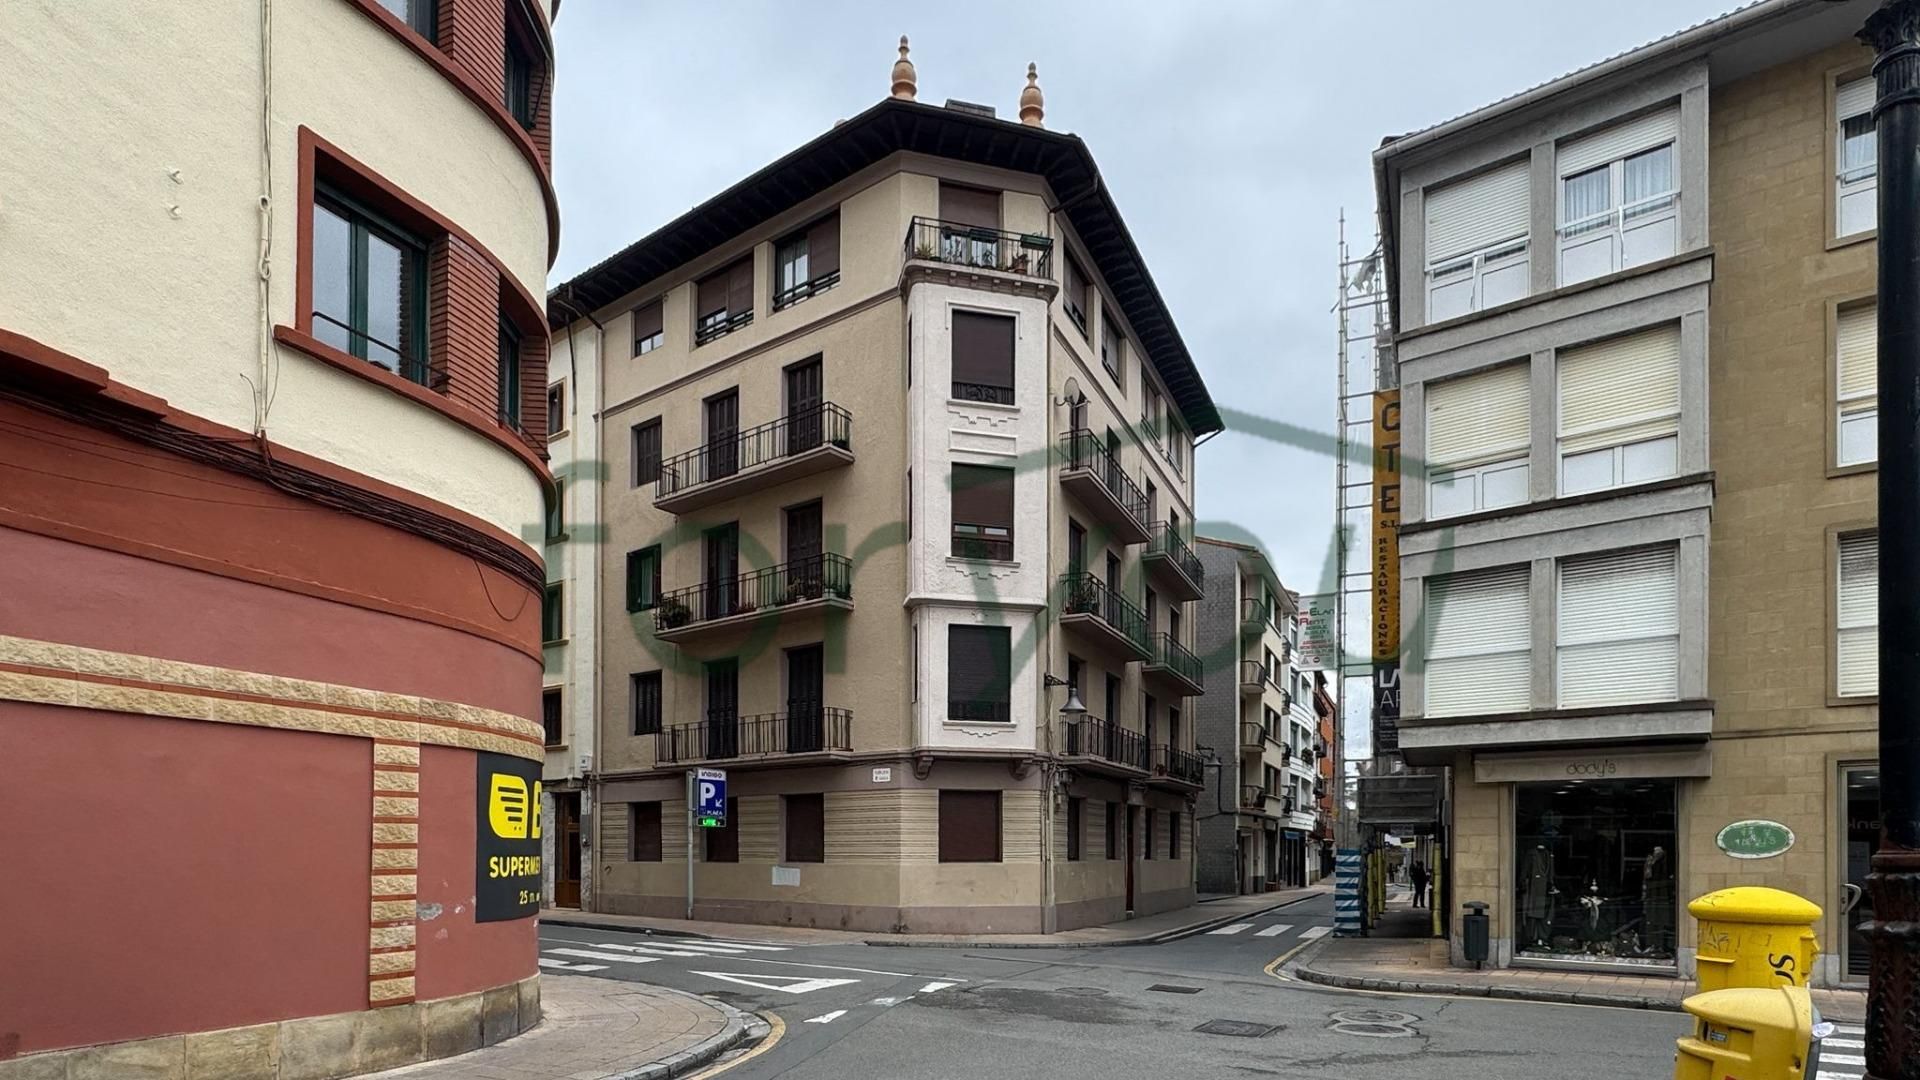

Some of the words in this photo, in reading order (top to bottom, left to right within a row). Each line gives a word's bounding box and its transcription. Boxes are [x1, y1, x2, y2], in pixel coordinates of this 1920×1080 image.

[1378, 537, 1389, 656] RESTAURACIONES
[1566, 760, 1616, 777] dody's
[700, 782, 716, 807] P
[518, 890, 528, 905] 25
